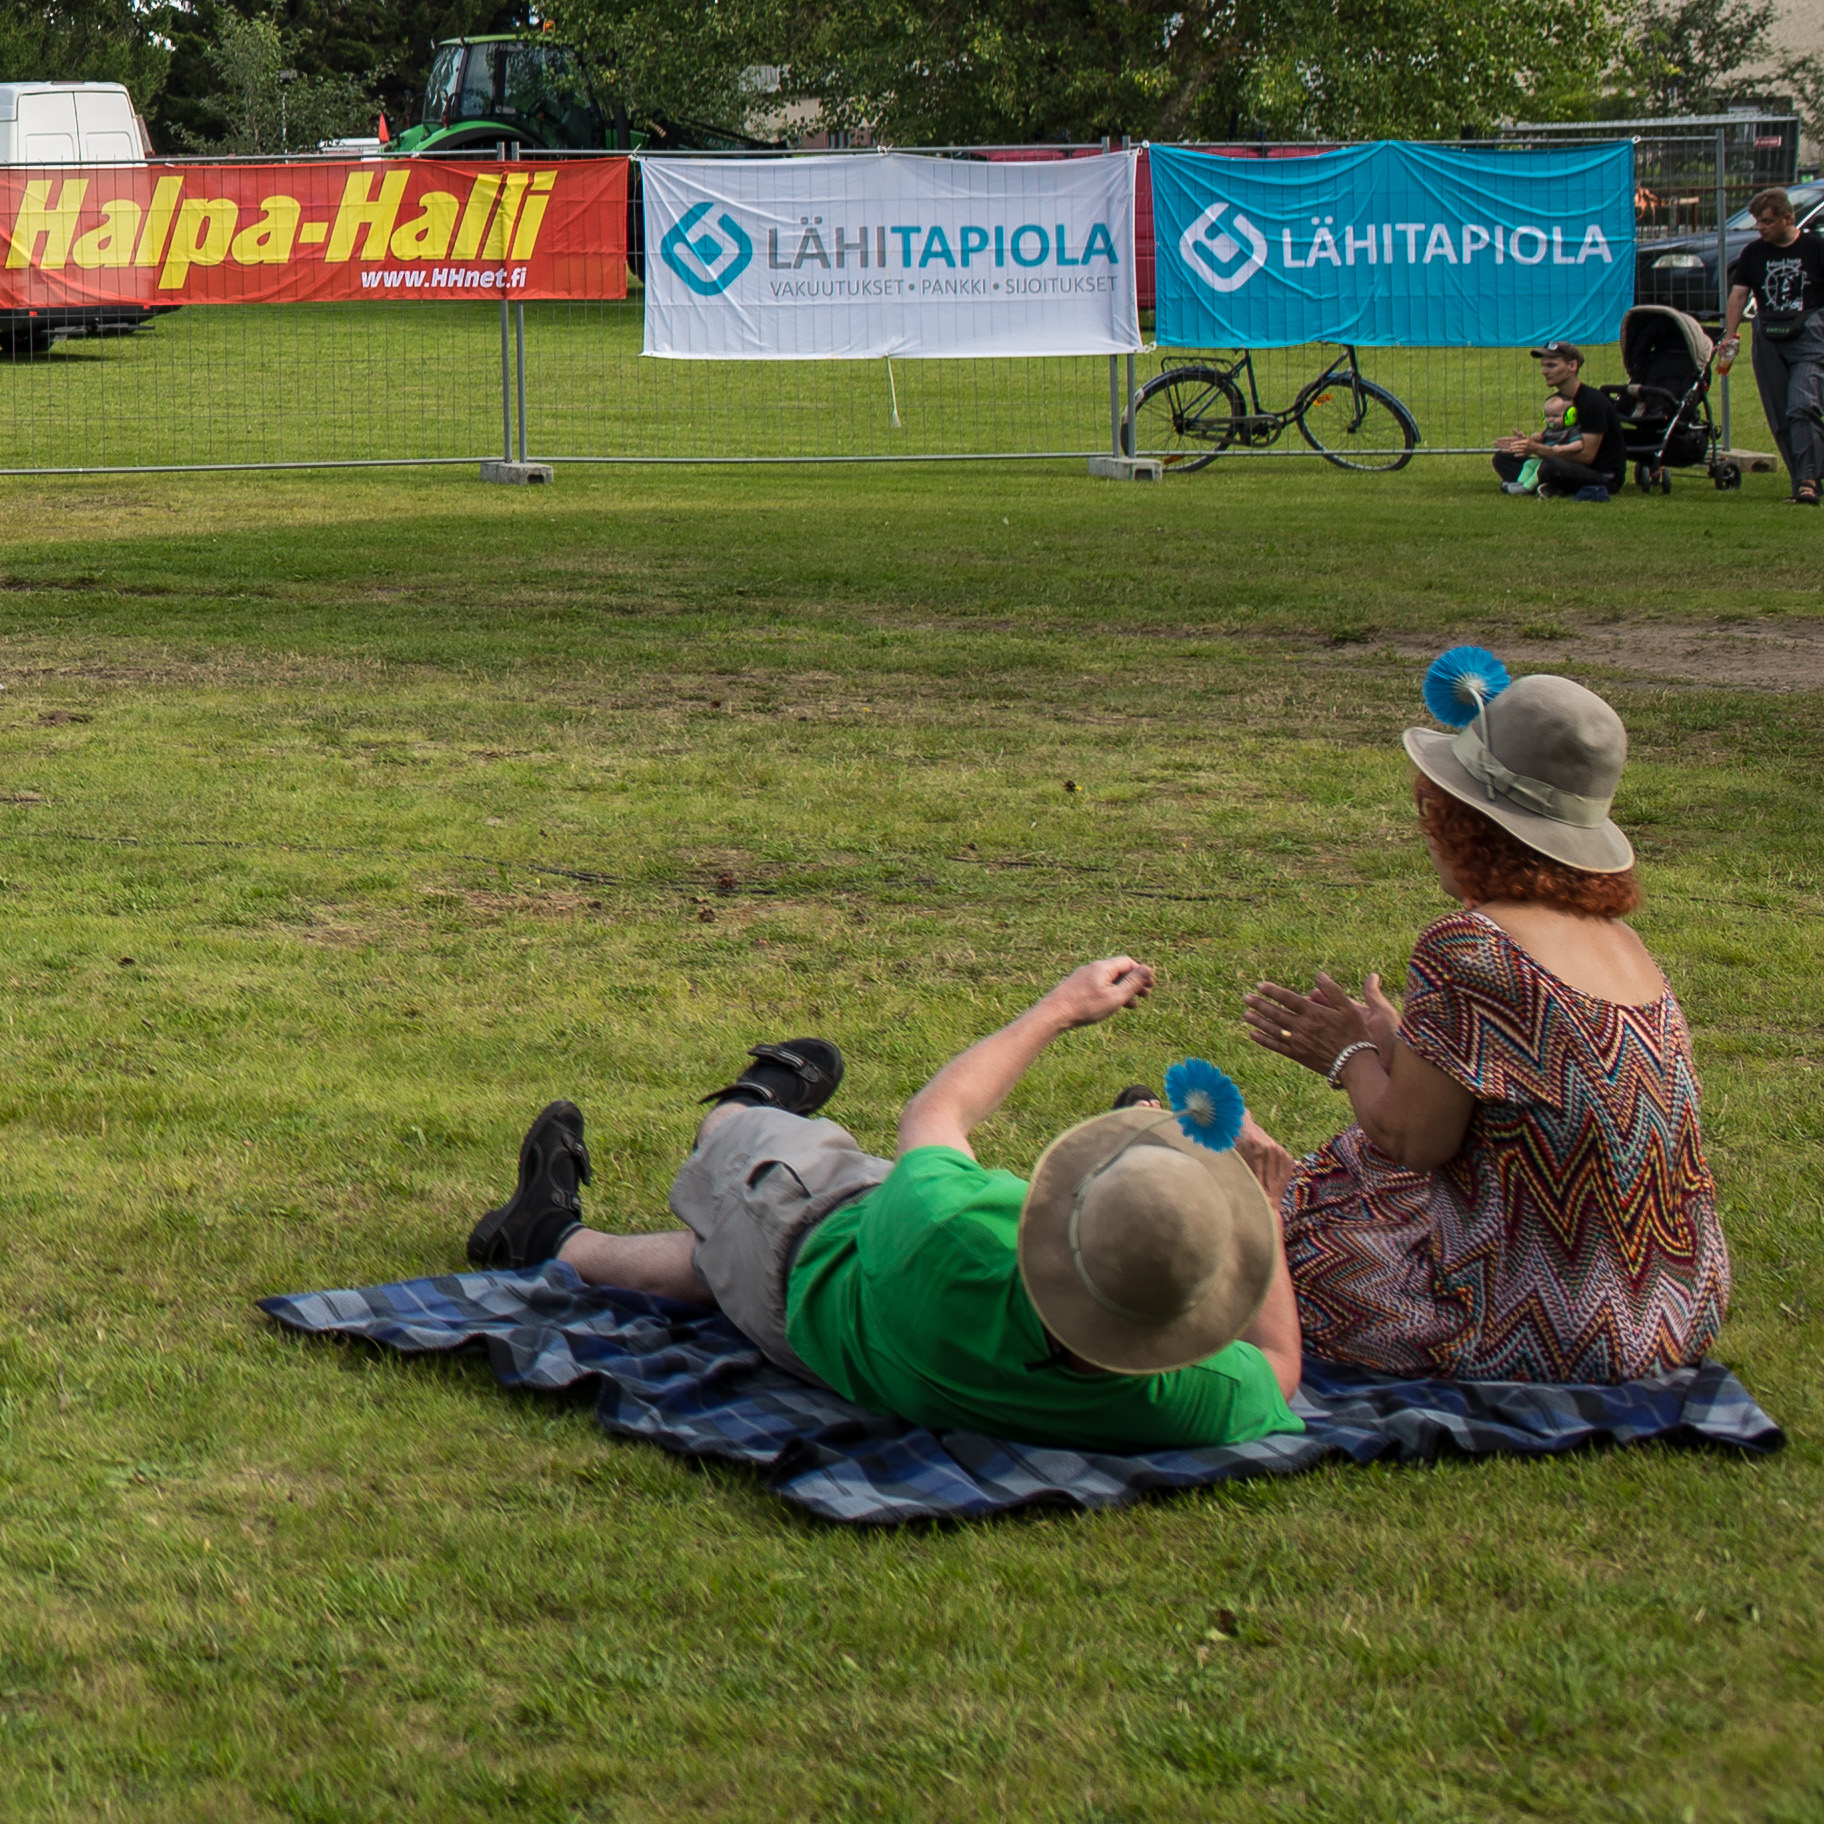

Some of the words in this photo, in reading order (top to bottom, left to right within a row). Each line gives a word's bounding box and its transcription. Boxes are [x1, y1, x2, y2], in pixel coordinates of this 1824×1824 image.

[4, 169, 559, 290] Halpa-Halli
[767, 216, 1119, 270] LÄHITAPIOLA
[1282, 216, 1613, 268] LÄHITAPIOLA
[360, 266, 527, 290] www.HHnet.fi
[770, 278, 905, 298] VAKUUTUKSET
[921, 278, 987, 296] PANKKI
[1004, 275, 1118, 295] SIJOITUKSET
